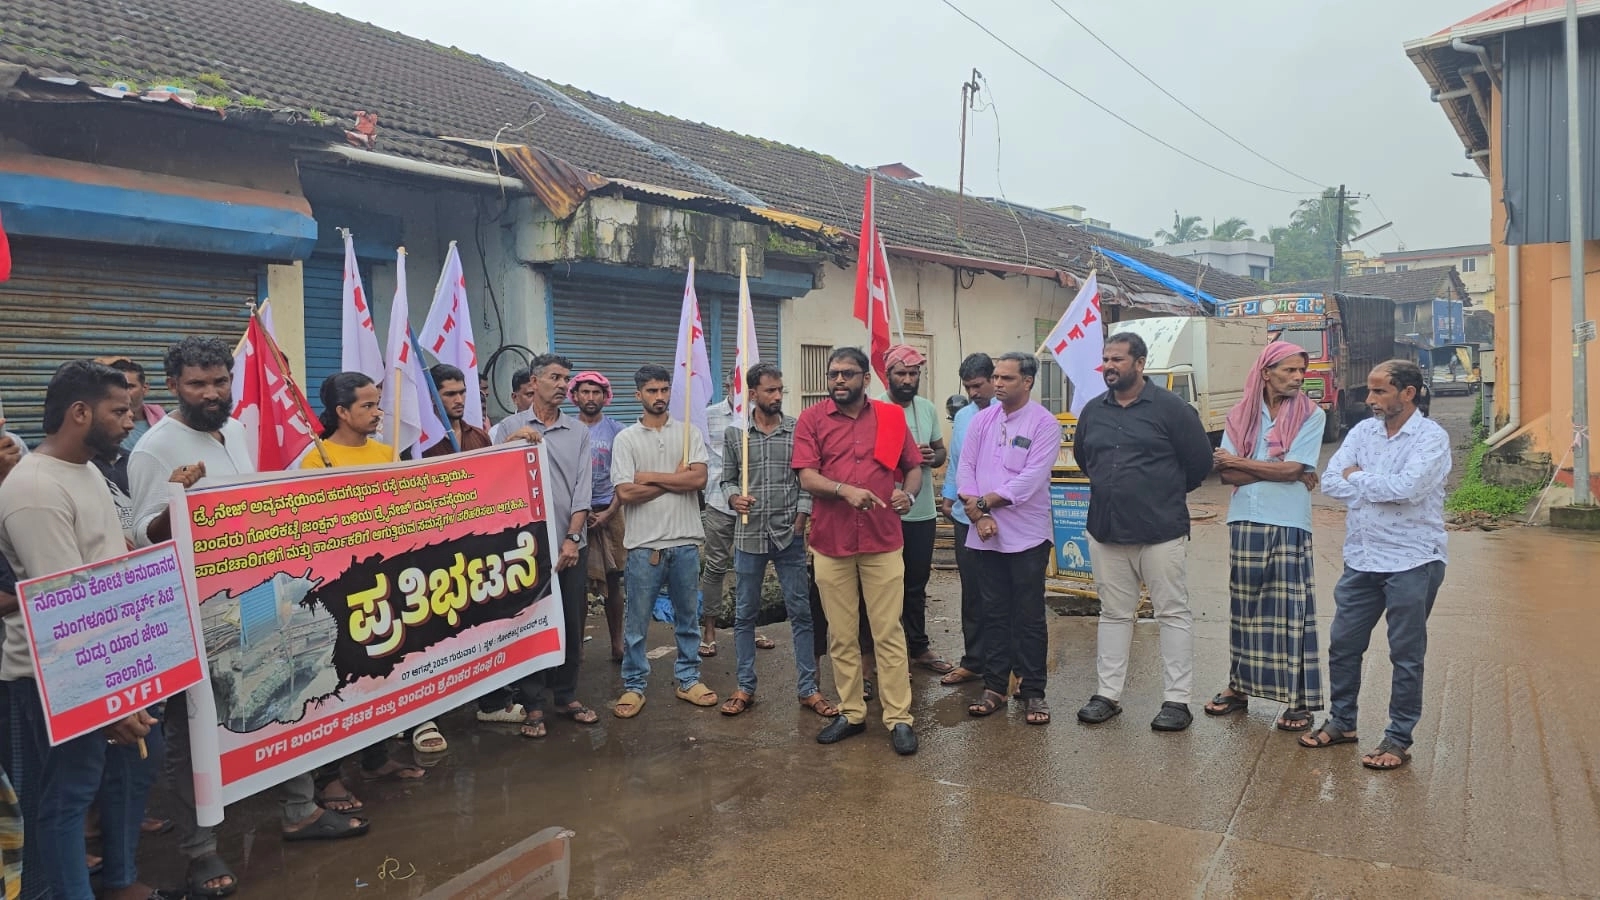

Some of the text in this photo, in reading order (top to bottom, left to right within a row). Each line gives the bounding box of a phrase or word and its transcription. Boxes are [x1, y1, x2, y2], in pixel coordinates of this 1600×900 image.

[1224, 300, 1260, 316] जय
[192, 500, 247, 527] ಡ್ರೈನೇಜ್
[249, 489, 326, 516] ಅವ್ಯವಸ್ಥೆಯಿಂದ
[382, 478, 399, 496] ರಸ್ತೆ
[526, 452, 541, 516] DYFI
[193, 532, 245, 553] ಬಂದರು
[302, 515, 339, 535] ಜಂಕ್ಷನ್
[341, 507, 373, 527] ಬಳಿಯ
[374, 501, 412, 523] ಡ್ರೈನೇಜ್
[195, 547, 285, 578] ಪಾದಚಾರಿಗಳಿಗೆ
[286, 543, 313, 560] ಮತ್ತು
[313, 529, 371, 553] ಕಾರ್ಮಿಕರಿಗೆ
[372, 522, 417, 542] ಆಗುತ್ತಿರುವ
[33, 554, 176, 612] ನೂರಾರು ಕೋಟಿ ಅನುದಾನದ
[346, 531, 539, 658] ಪ್ರತಿಭಟನೆ
[52, 587, 175, 640] ಮಂಗಳೂರು ಸ್ಮಾರ್ಟ್ ಸಿಟಿ
[75, 622, 169, 666] ದುಡ್ಡು ಯಾರ ಜೇಬು
[401, 671, 410, 681] 07
[432, 657, 449, 669] 2025
[104, 654, 157, 689] ಪಾಲಾಗಿದೆ.
[106, 678, 163, 714] DYFI
[255, 742, 288, 763] DYFI
[290, 721, 341, 750] ಬಂದರ್
[375, 701, 396, 716] ಮತ್ತು
[397, 683, 436, 708] ಬಂದರು
[437, 668, 472, 694] ಶ್ರಮಿಕರ
[472, 658, 494, 677] ಸಂಘ
[494, 651, 506, 668] (ರಿ)
